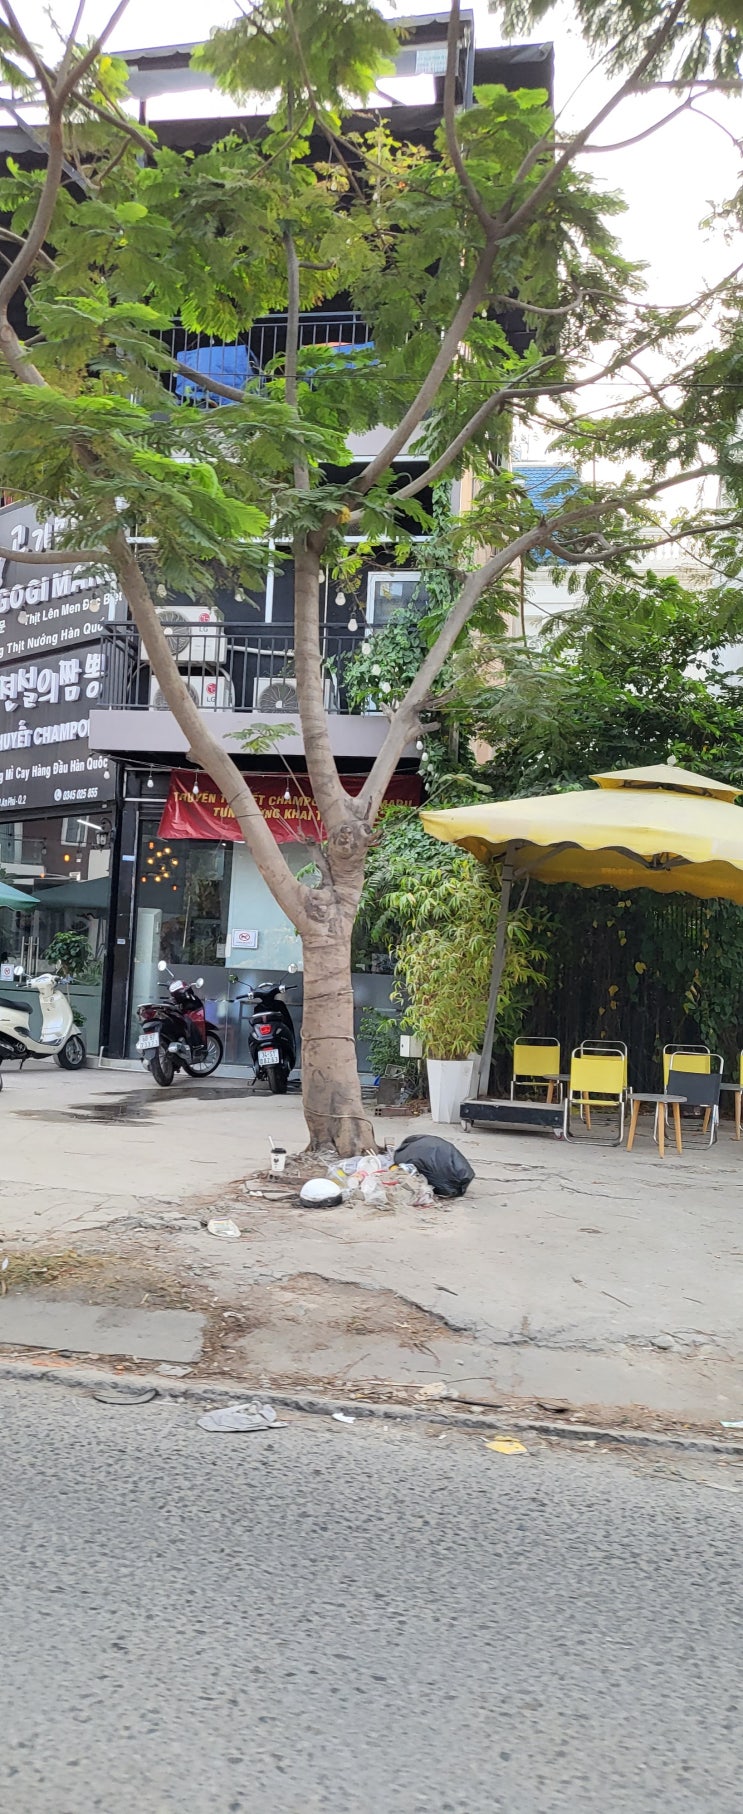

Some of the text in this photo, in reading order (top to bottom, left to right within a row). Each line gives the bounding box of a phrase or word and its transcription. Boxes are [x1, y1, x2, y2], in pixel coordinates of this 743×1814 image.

[42, 607, 60, 621] Lên
[61, 602, 81, 616] Men
[7, 640, 25, 653] Thịt
[27, 633, 58, 649] Nướng
[60, 627, 80, 641] Hàn
[33, 719, 90, 746] CHAMPO
[16, 766, 30, 781] Cay
[32, 764, 51, 779] Hàng
[53, 759, 68, 775] Đầu
[70, 759, 85, 773] Hàn
